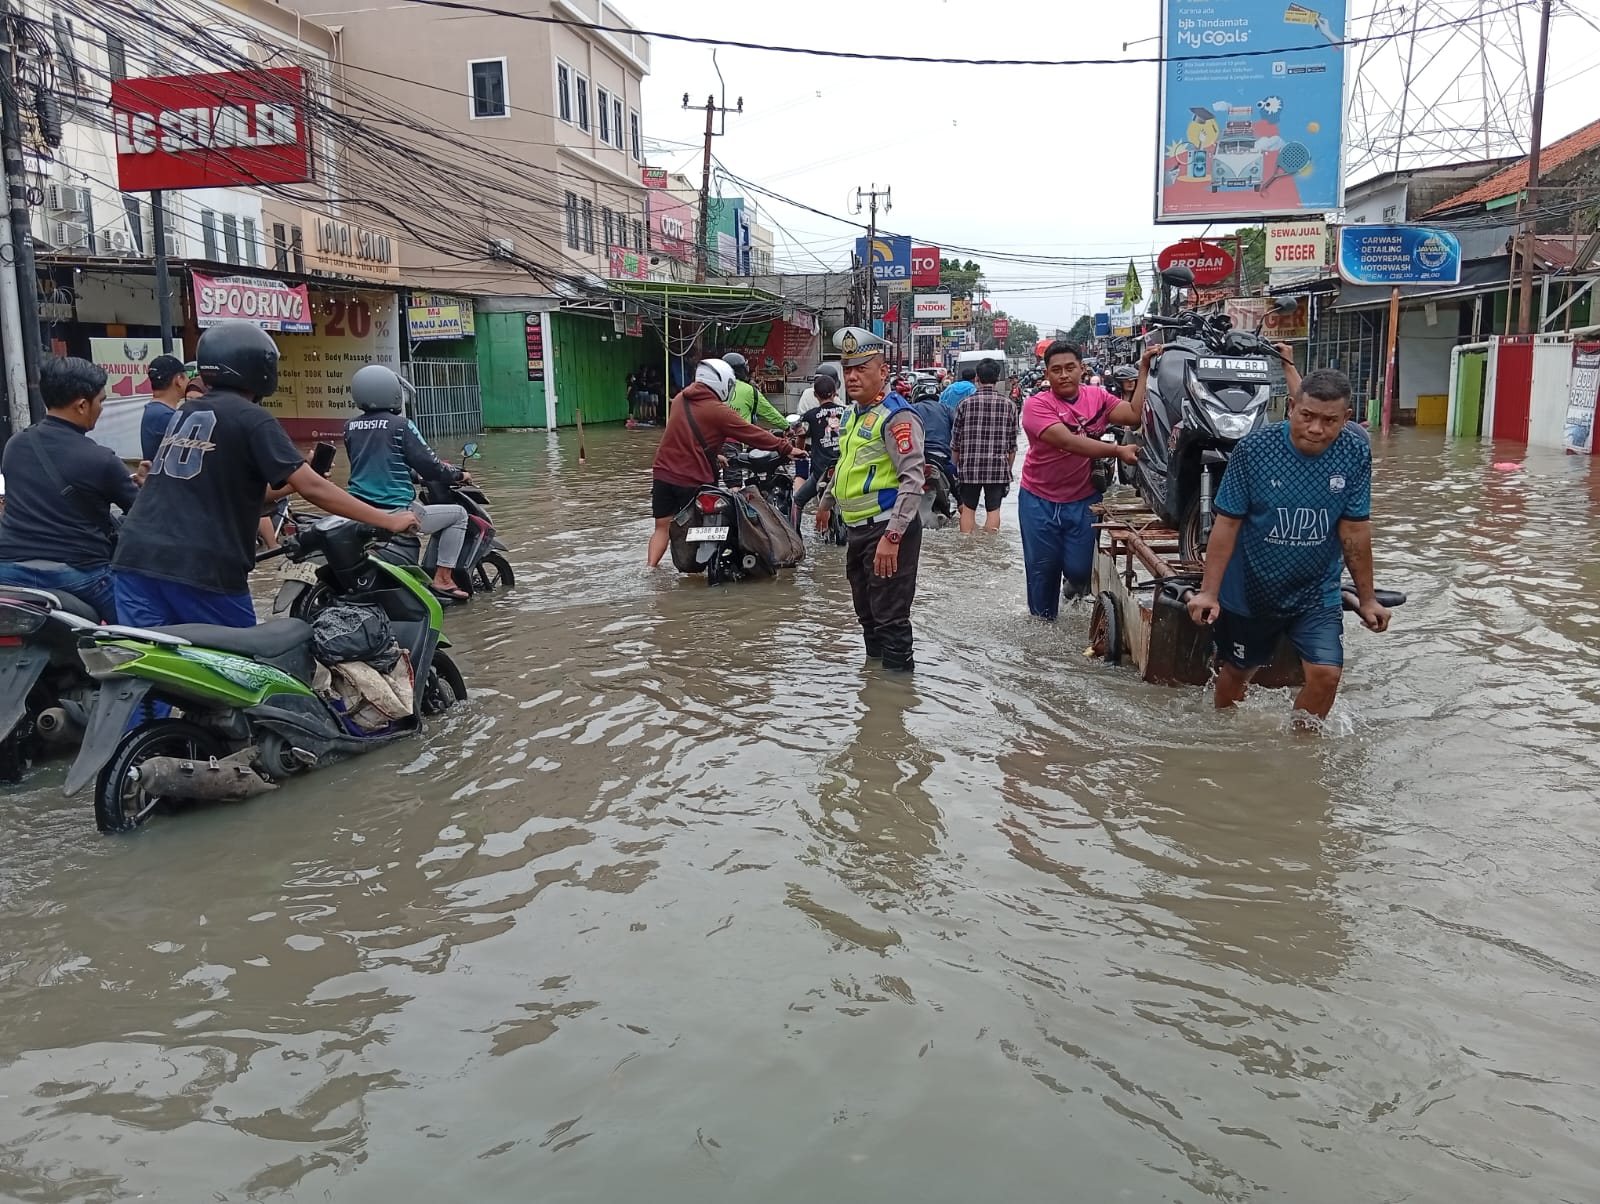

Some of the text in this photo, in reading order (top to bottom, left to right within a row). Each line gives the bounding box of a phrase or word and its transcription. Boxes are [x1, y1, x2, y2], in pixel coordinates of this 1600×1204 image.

[1178, 17, 1248, 30] bjb Tandamata
[646, 170, 665, 178] AMS
[1271, 227, 1321, 238] SEWA/JUAL
[1362, 236, 1403, 244] CARWASH
[1275, 244, 1316, 261] STEGER
[1361, 245, 1402, 253] DETAILING
[912, 257, 935, 270] TO
[1170, 257, 1224, 268] PROBAN
[1361, 254, 1411, 263] BODYREPAIR
[873, 265, 906, 277] eka
[1360, 263, 1411, 272] MOTORWASH
[200, 286, 304, 320] SPOORING
[324, 300, 371, 339] 20
[411, 319, 459, 329] MAJU JAYA
[324, 352, 342, 363] Body
[343, 353, 373, 363] Massage
[283, 370, 301, 378] Color
[326, 369, 343, 378] Lulur
[328, 400, 346, 410] Royal
[349, 419, 389, 430] OPOSISI FC
[1233, 641, 1245, 659] 3
